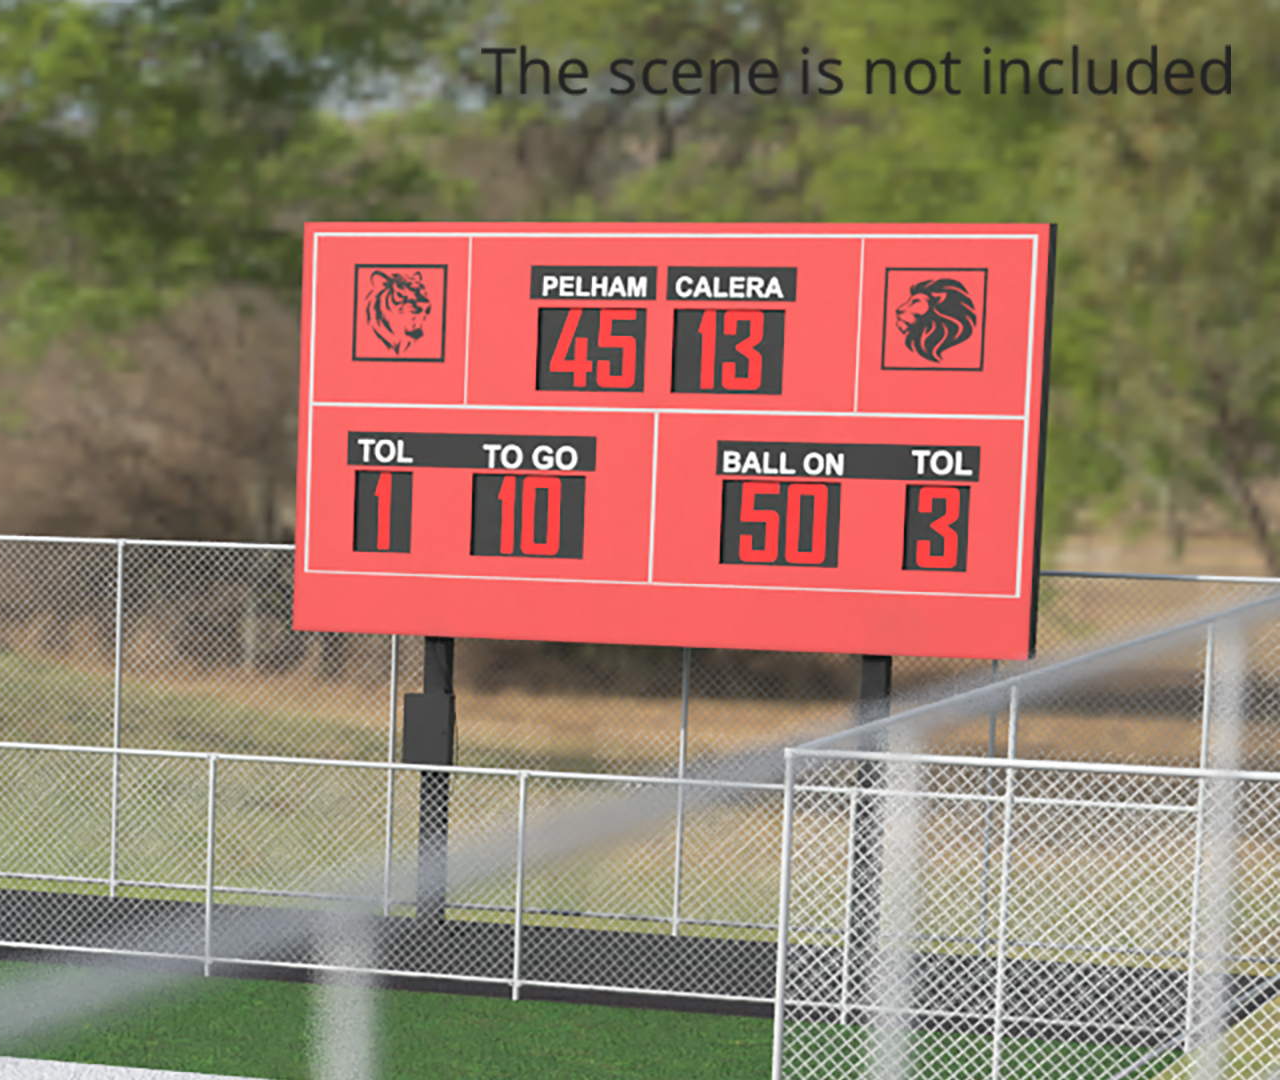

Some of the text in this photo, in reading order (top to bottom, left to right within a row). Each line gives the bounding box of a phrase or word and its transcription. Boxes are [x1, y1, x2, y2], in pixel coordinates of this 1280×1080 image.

[542, 276, 648, 298] PELHAM
[676, 276, 784, 299] CALERA
[549, 308, 637, 387] 45
[698, 310, 765, 391] 13
[358, 438, 414, 464] TOL
[482, 443, 579, 471] TO GO
[723, 450, 845, 477] BALL ON
[912, 449, 974, 477] TOL
[374, 472, 393, 550] 1
[498, 475, 563, 555] 10
[738, 482, 829, 565] 50
[916, 487, 961, 569] 3
